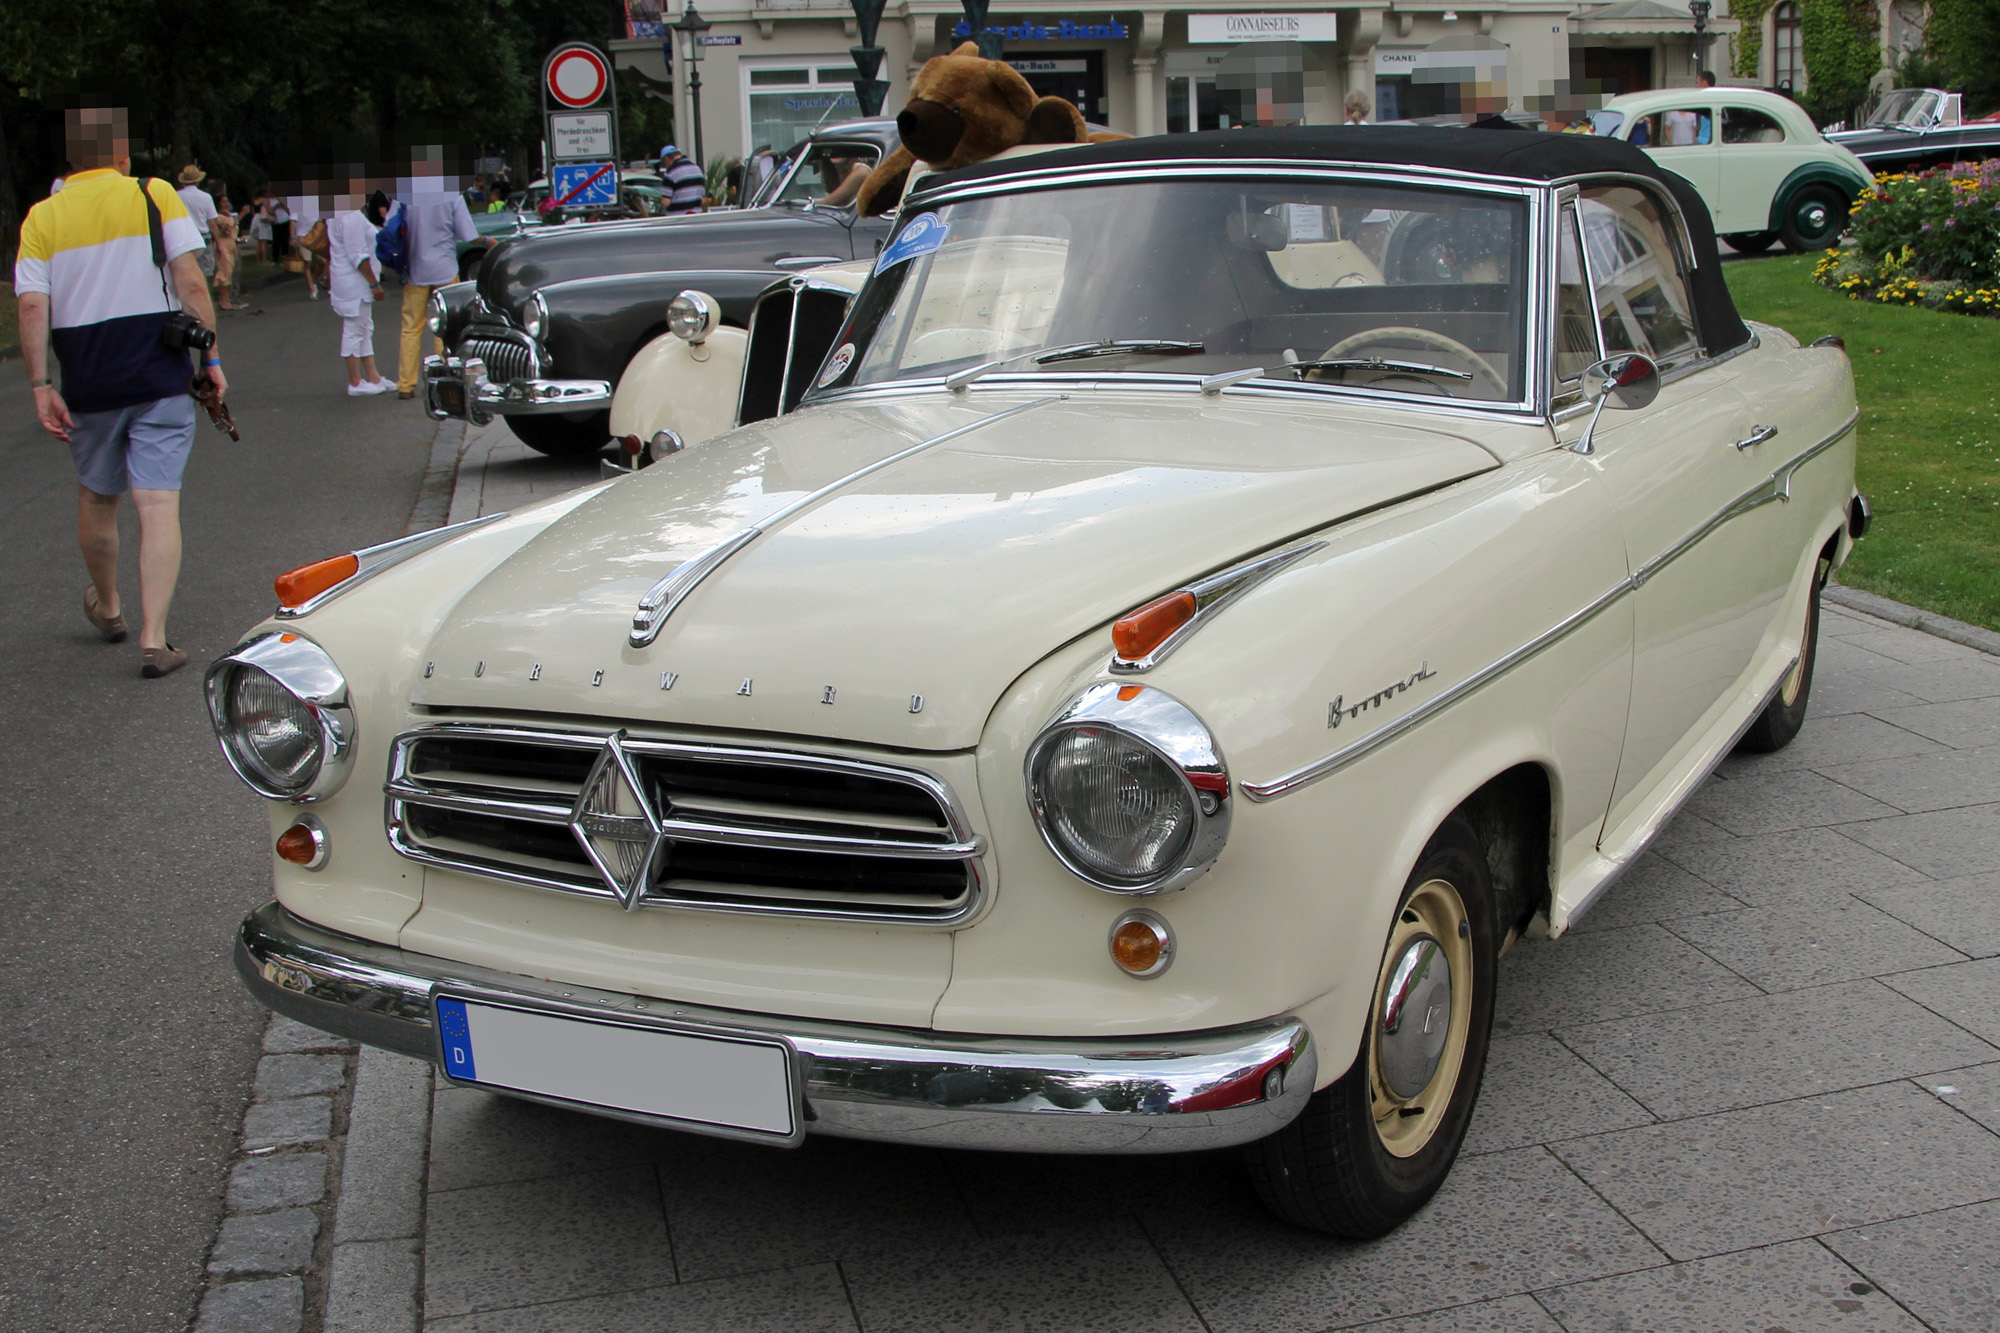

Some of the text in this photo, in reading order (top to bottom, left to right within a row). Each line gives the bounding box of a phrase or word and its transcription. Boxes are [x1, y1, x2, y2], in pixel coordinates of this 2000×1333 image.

[955, 20, 1126, 40] Sarda-Bank
[1226, 15, 1299, 32] CONNAISSEURS
[557, 127, 606, 135] Pferdedroschken
[423, 659, 925, 714] BORGWARD
[453, 1046, 465, 1064] D
